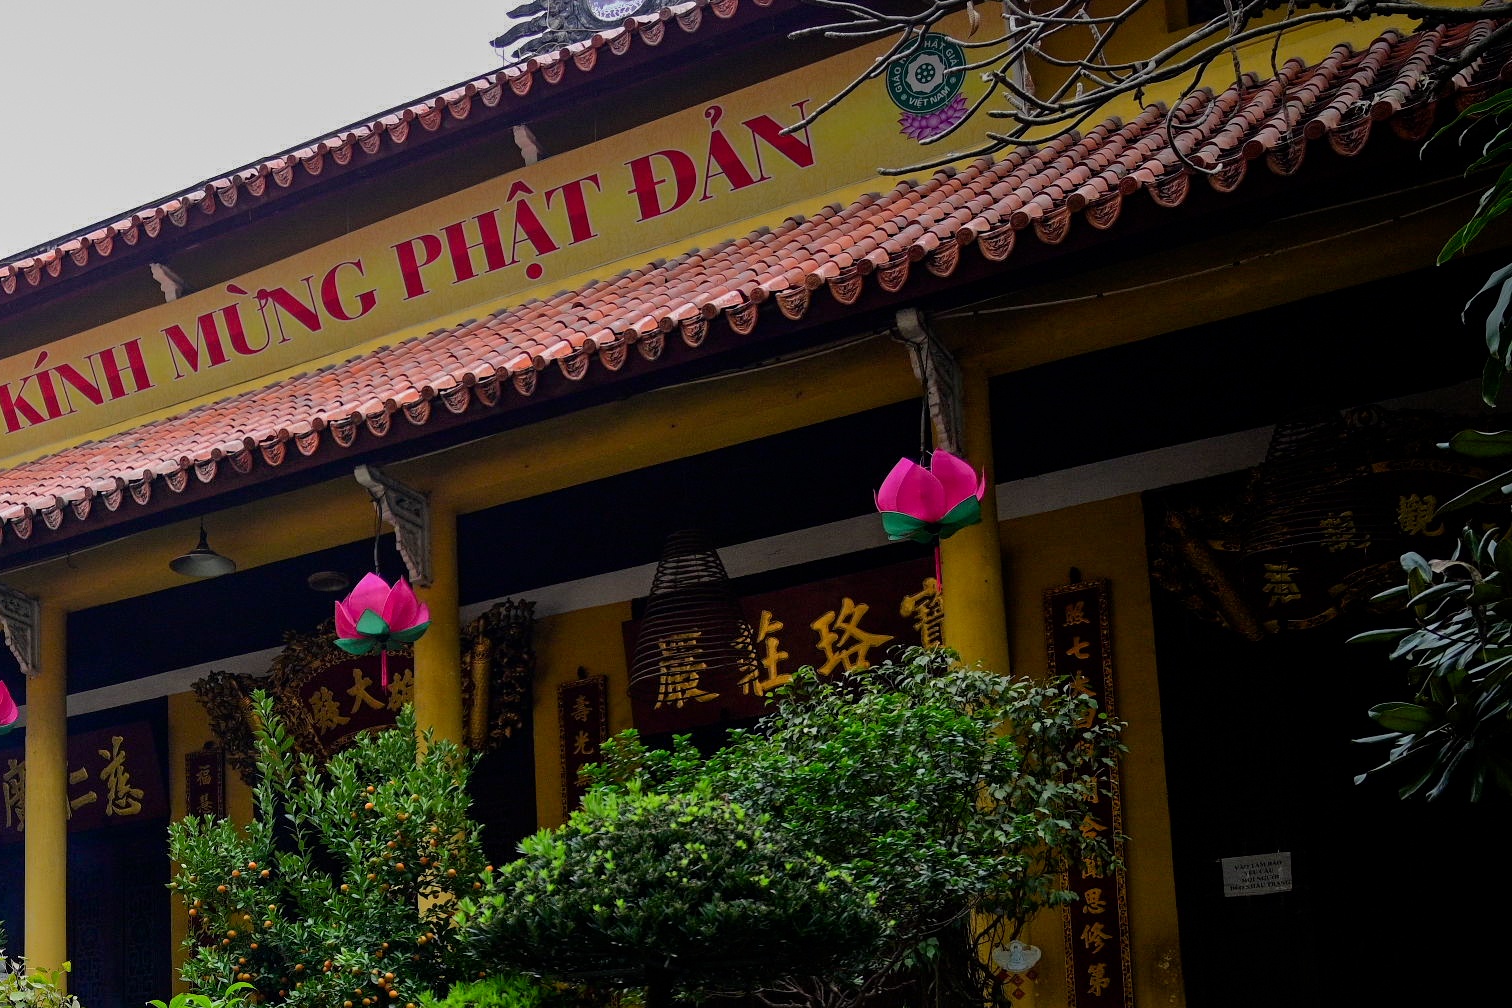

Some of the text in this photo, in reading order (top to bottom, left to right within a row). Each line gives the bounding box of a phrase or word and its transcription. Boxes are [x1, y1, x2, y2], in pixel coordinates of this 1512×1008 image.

[922, 38, 946, 52] HẬT
[945, 49, 960, 66] GIÁ
[908, 86, 951, 109] VIỆT NAM
[160, 258, 377, 380] MỪNG
[390, 173, 602, 301] PHẬT
[627, 100, 816, 222] ĐẢN
